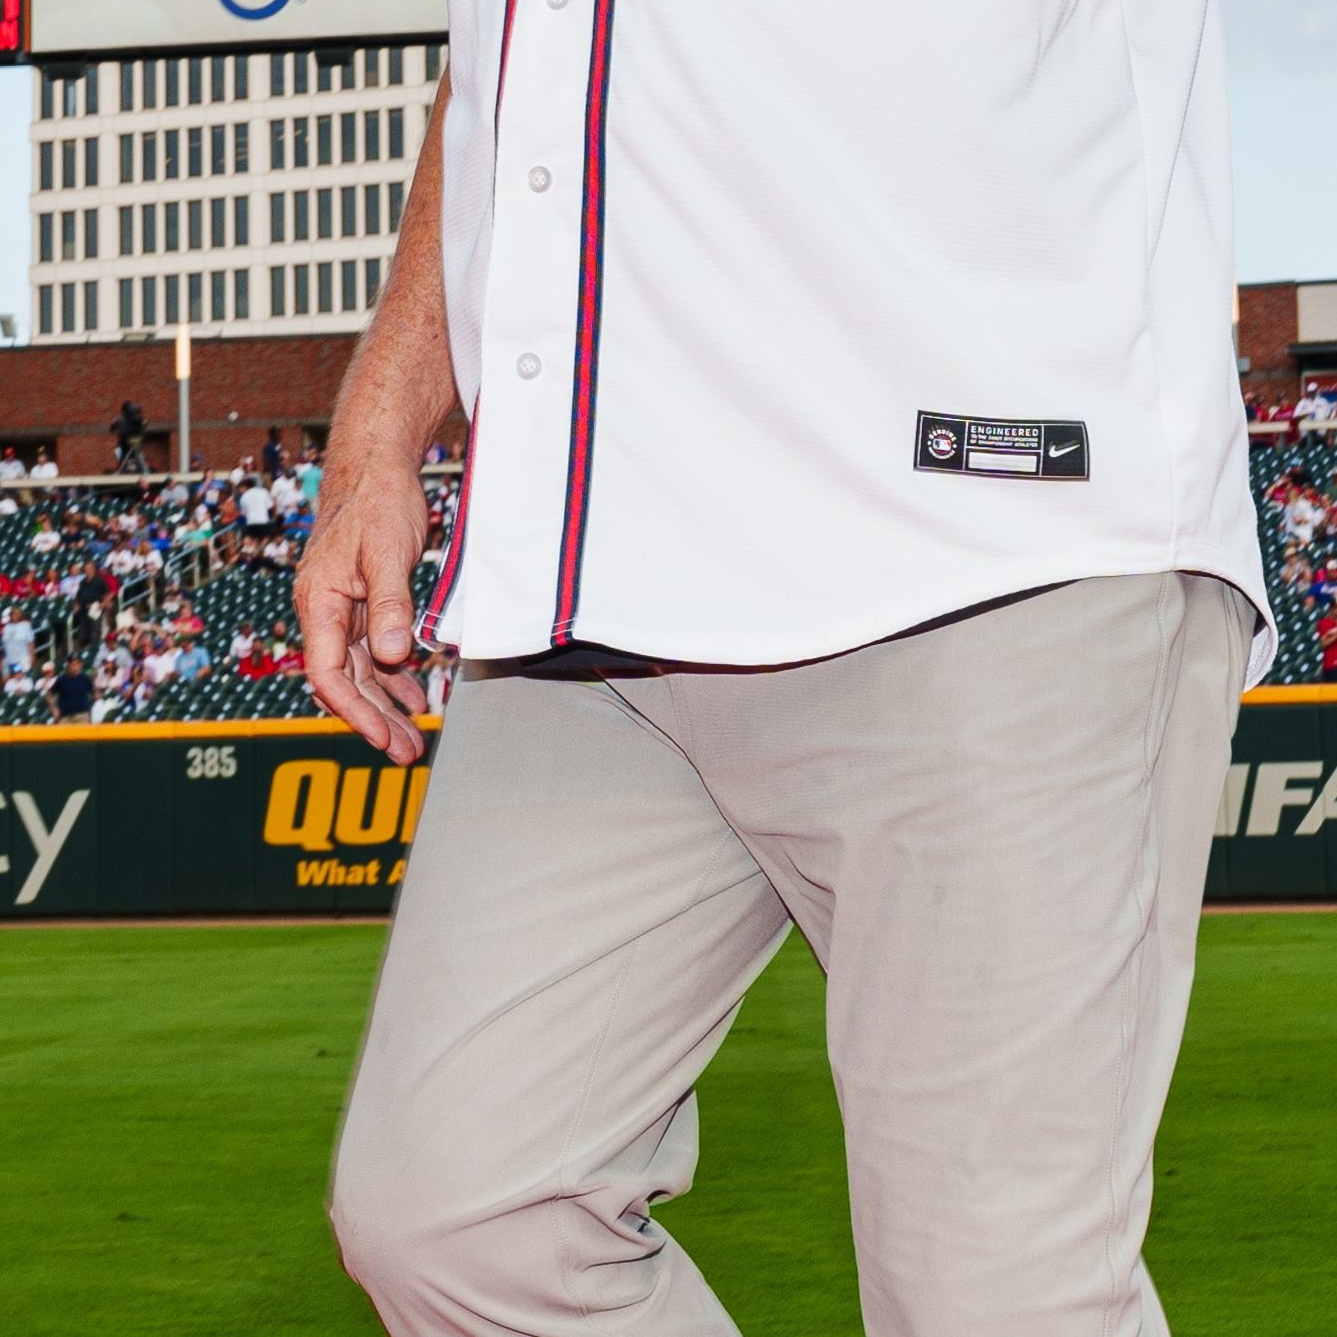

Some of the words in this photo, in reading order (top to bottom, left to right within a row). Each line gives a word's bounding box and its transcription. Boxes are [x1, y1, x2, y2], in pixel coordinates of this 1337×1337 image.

[970, 425, 1039, 437] ENGINEERED
[186, 746, 237, 779] 385
[296, 858, 381, 887] What
